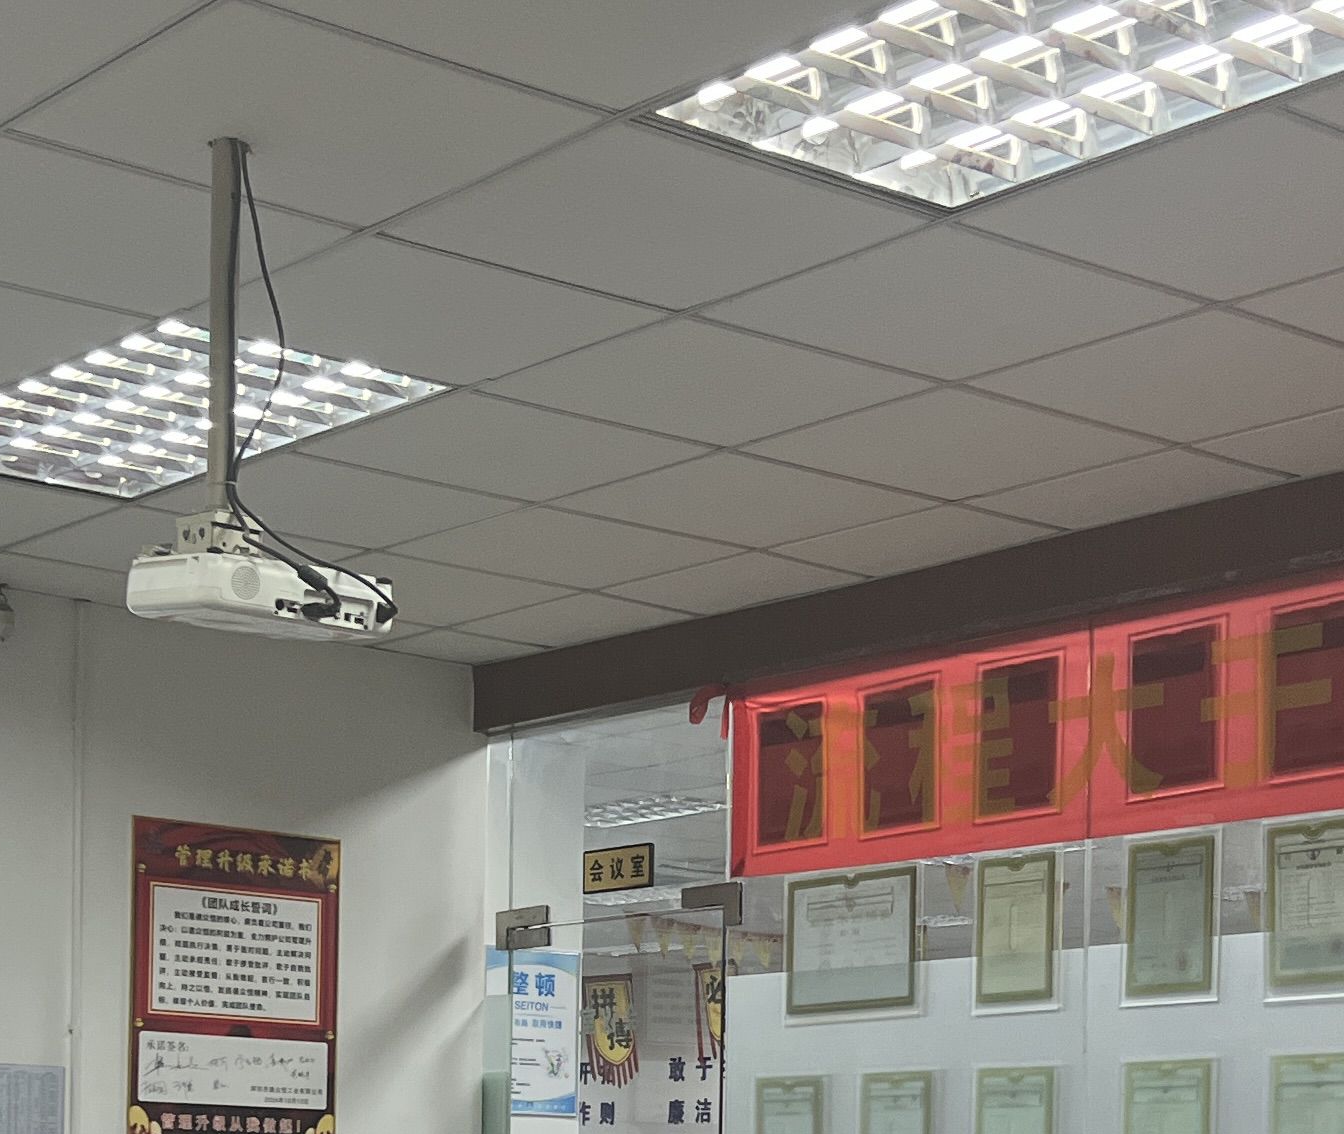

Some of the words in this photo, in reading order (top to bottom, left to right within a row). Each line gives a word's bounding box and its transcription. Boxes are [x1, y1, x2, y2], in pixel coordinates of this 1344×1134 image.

[588, 854, 646, 882] 会议室
[514, 1000, 550, 1012] SEITON
